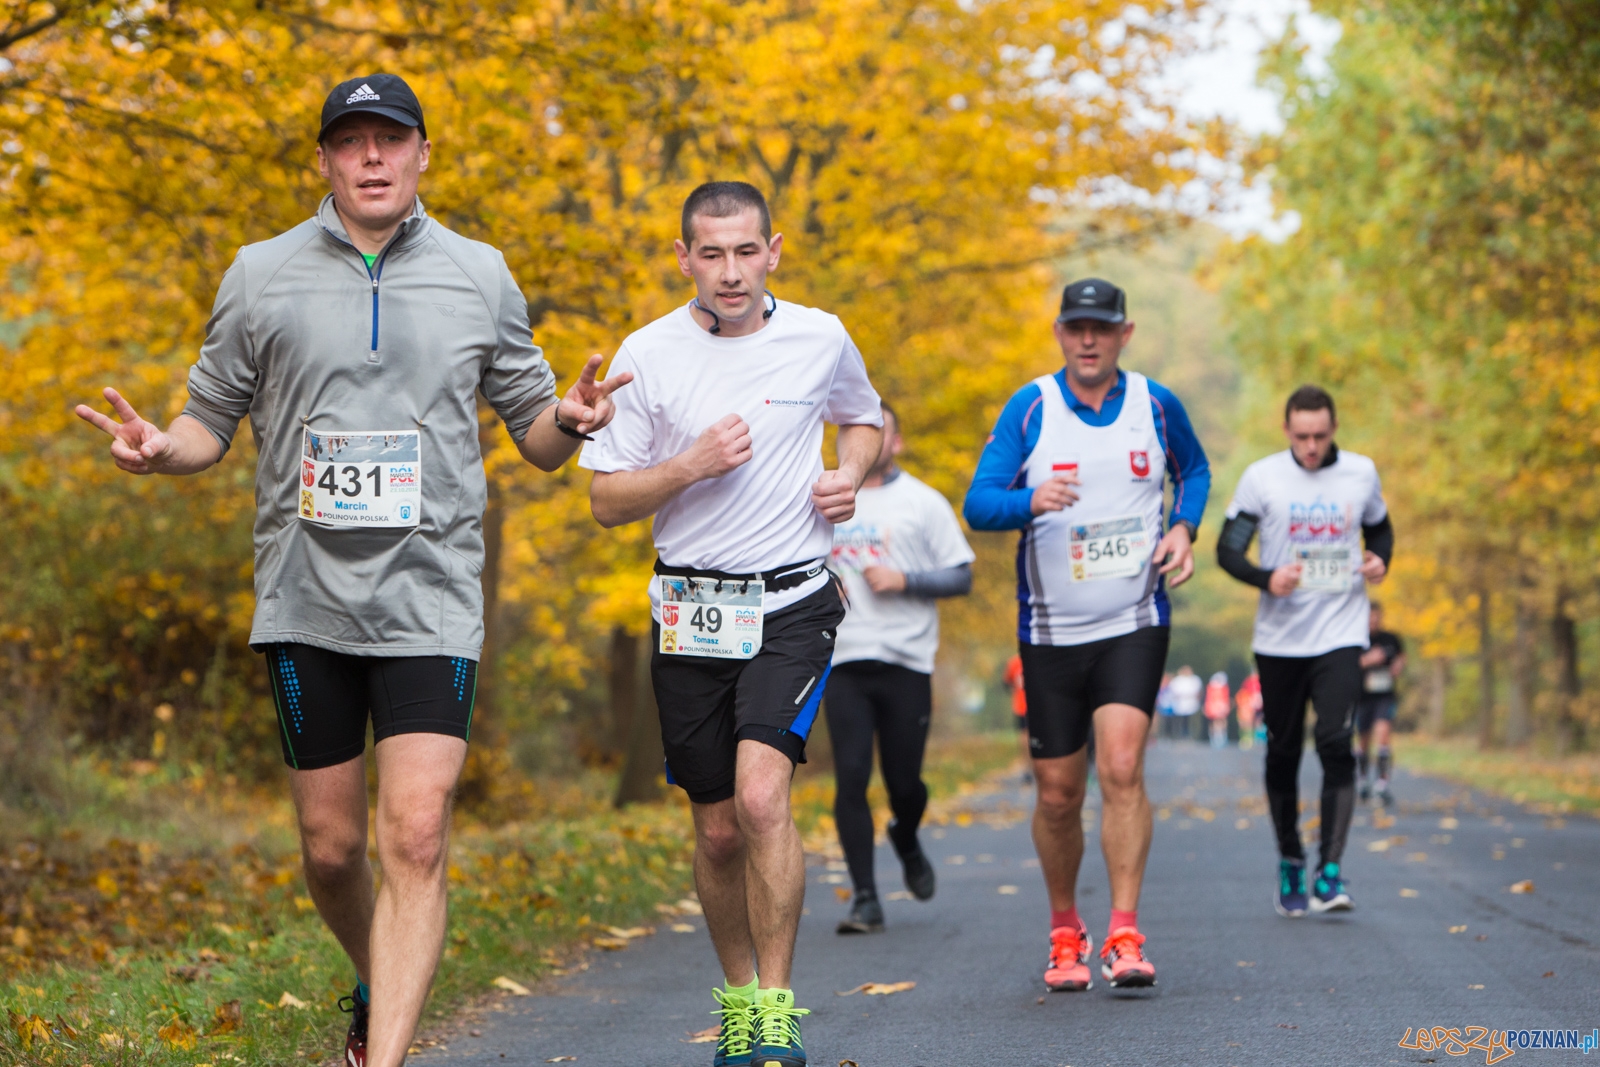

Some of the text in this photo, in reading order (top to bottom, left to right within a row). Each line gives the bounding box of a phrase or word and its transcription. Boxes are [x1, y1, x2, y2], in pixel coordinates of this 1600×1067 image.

[346, 94, 380, 104] adidas
[317, 464, 382, 498] 431
[334, 500, 369, 511] Marcin
[323, 512, 359, 521] POLINOVA
[1087, 537, 1129, 562] 546
[690, 605, 723, 634] 49
[693, 635, 719, 645] Tomasz
